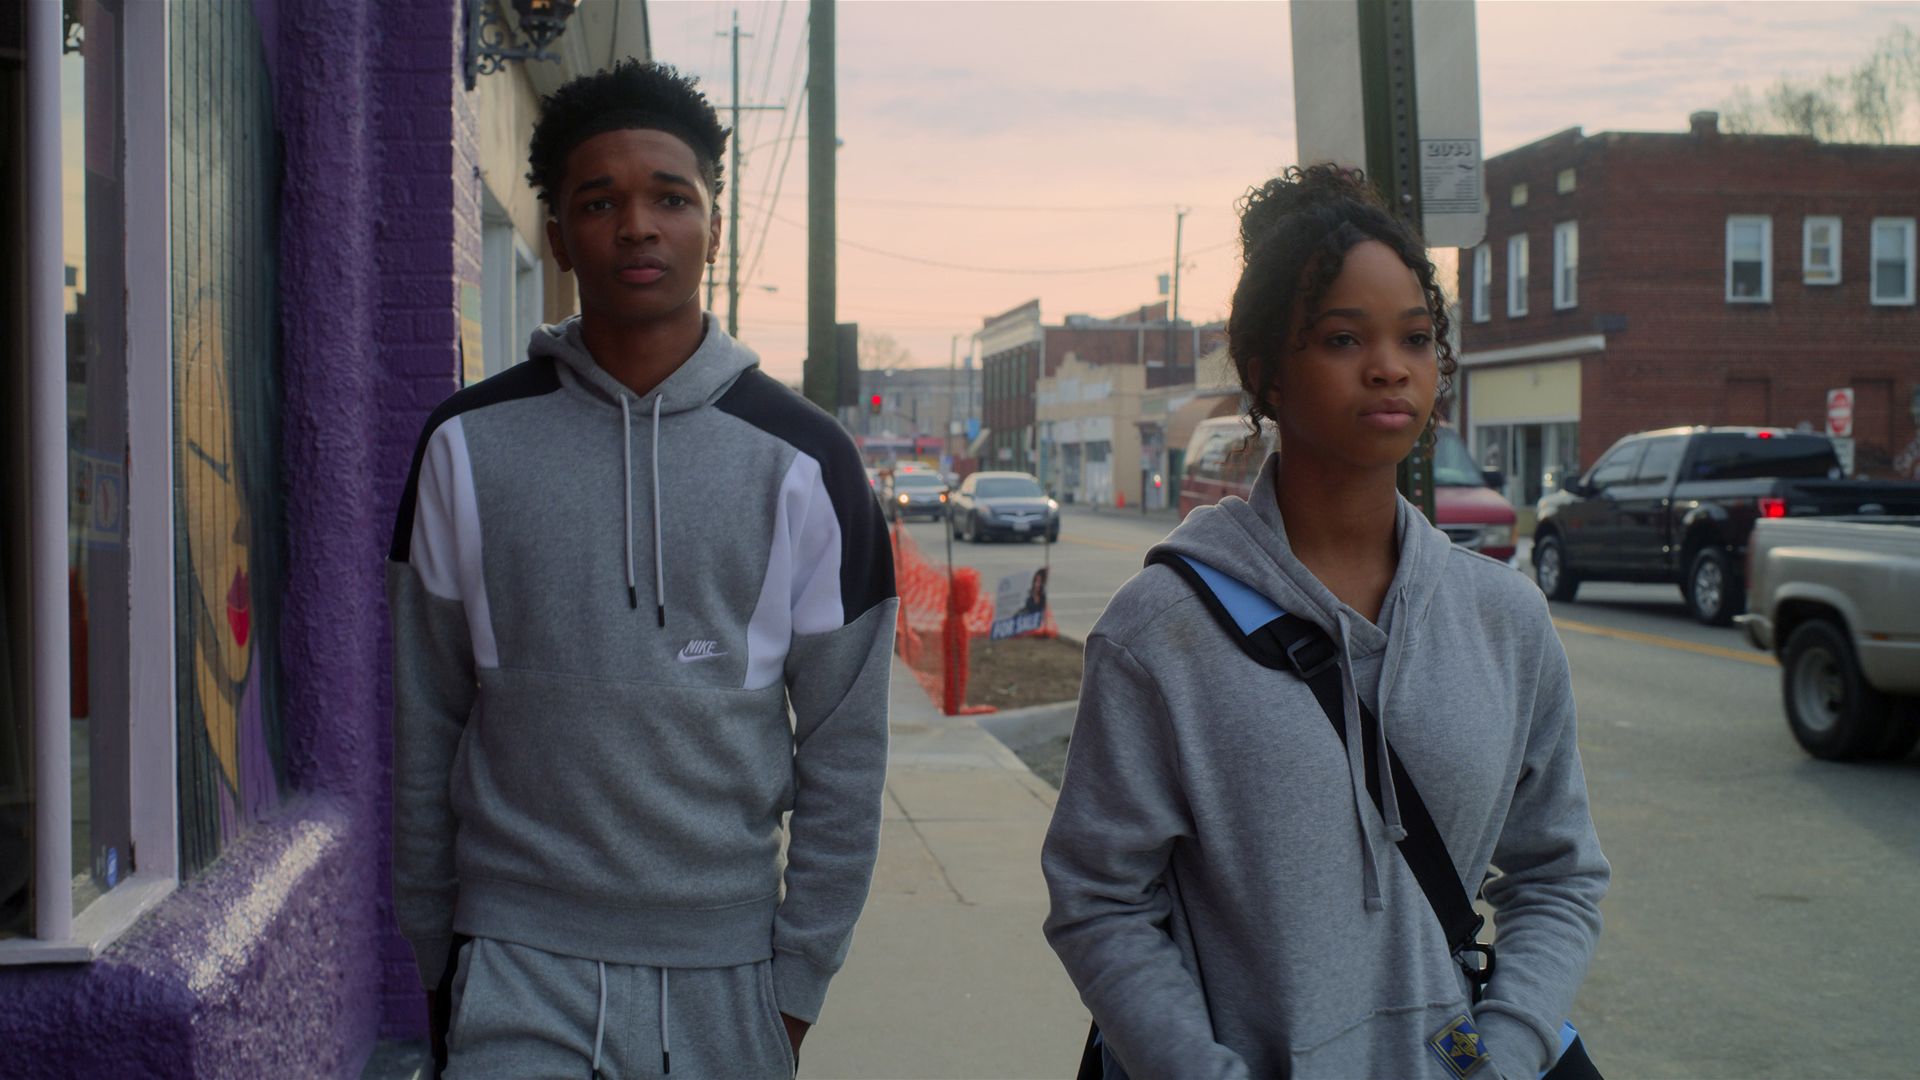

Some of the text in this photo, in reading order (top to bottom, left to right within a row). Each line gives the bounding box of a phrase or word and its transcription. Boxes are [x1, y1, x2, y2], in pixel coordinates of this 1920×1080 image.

[993, 612, 1041, 639] FOR SALE
[684, 639, 718, 655] NIKE
